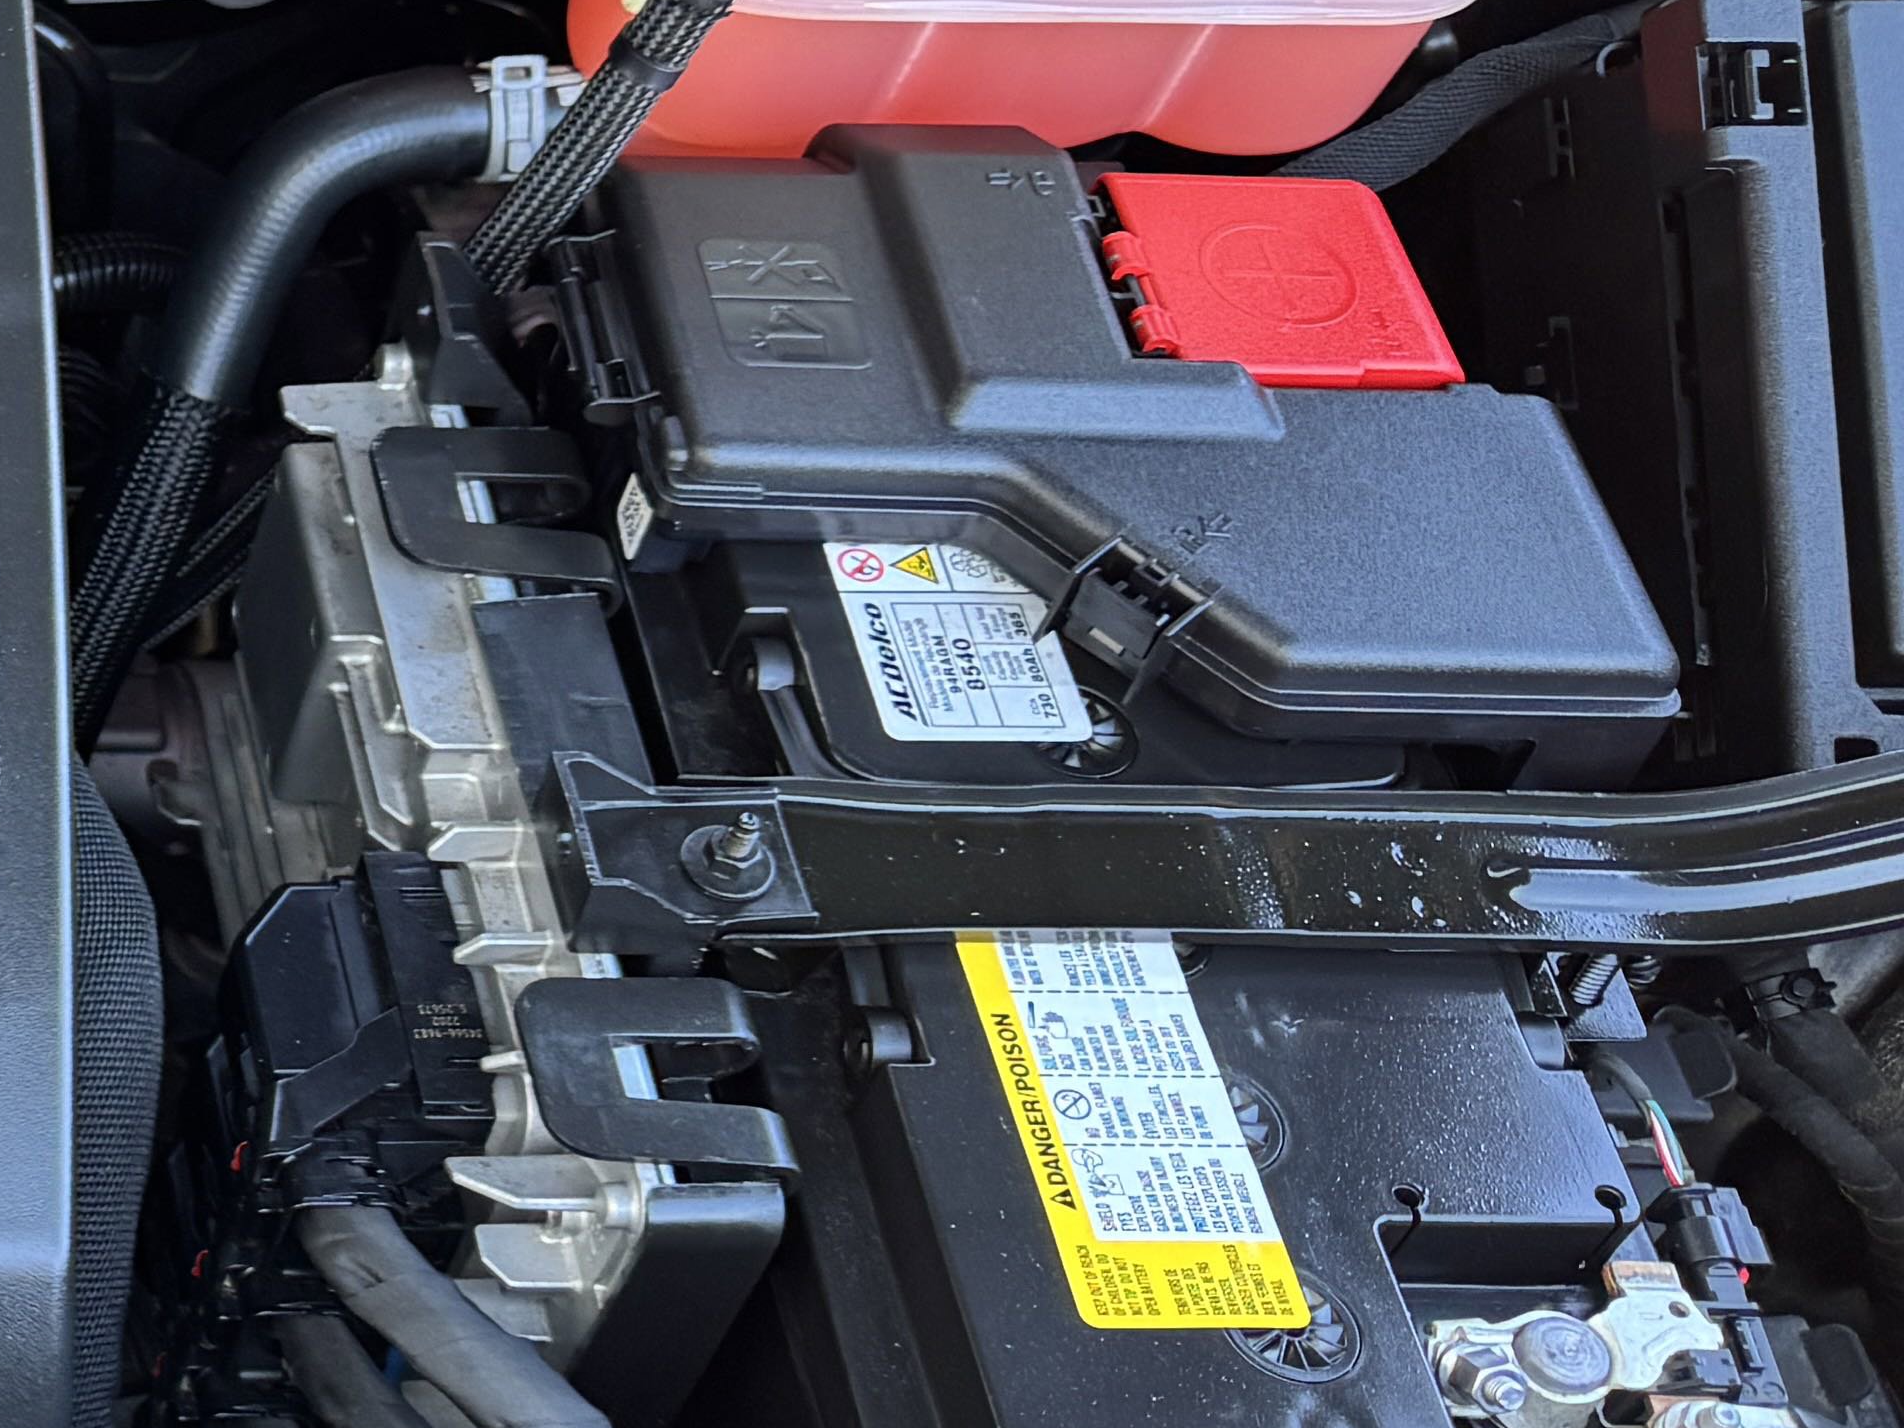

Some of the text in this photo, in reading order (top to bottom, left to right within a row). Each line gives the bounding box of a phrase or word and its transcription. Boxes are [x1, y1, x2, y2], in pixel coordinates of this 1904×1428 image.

[864, 602, 917, 720] ACDelco
[949, 638, 986, 690] 8540
[1037, 693, 1057, 718] 730
[990, 1013, 1069, 1185] DANGER/POISON
